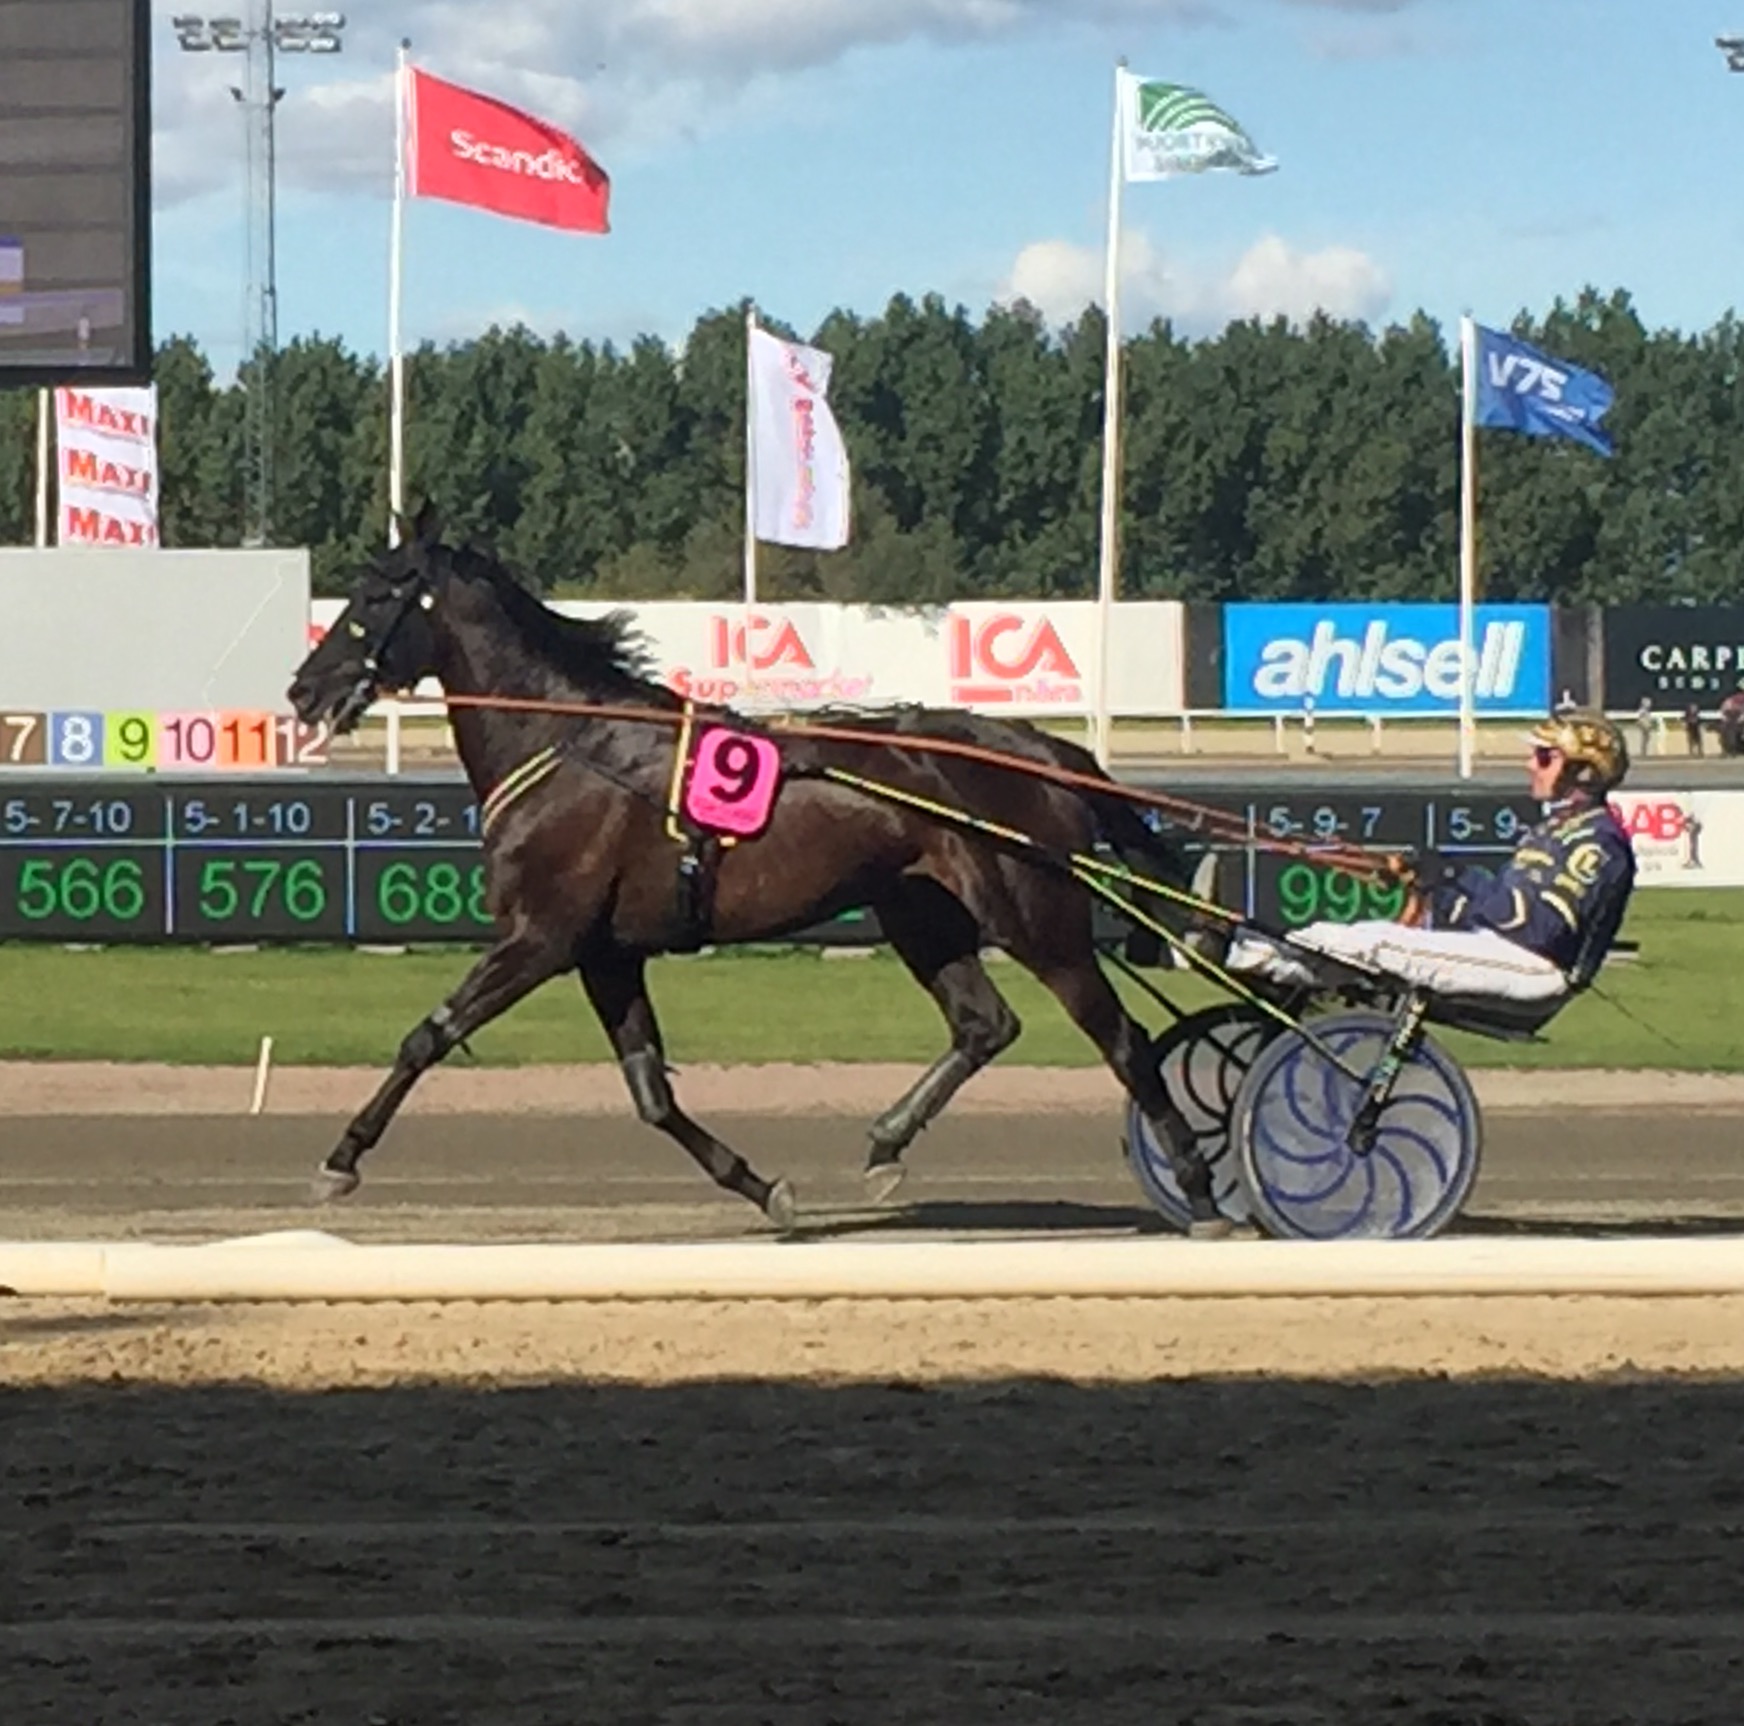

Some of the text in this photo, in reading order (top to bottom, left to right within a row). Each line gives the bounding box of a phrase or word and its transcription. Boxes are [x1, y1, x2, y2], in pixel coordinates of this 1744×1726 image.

[450, 128, 583, 184] Scandic
[65, 389, 149, 436] MAXI
[67, 449, 151, 494] MAXI
[712, 614, 815, 669] ICA
[951, 614, 1081, 679] ICA
[1253, 619, 1525, 699] ahlsell
[3, 715, 328, 764] 7 8 9 10 11 12
[709, 736, 761, 803] 9
[1610, 802, 1684, 841] AB
[17, 858, 144, 921] 566
[199, 858, 326, 922] 576
[1277, 864, 1405, 924] 999
